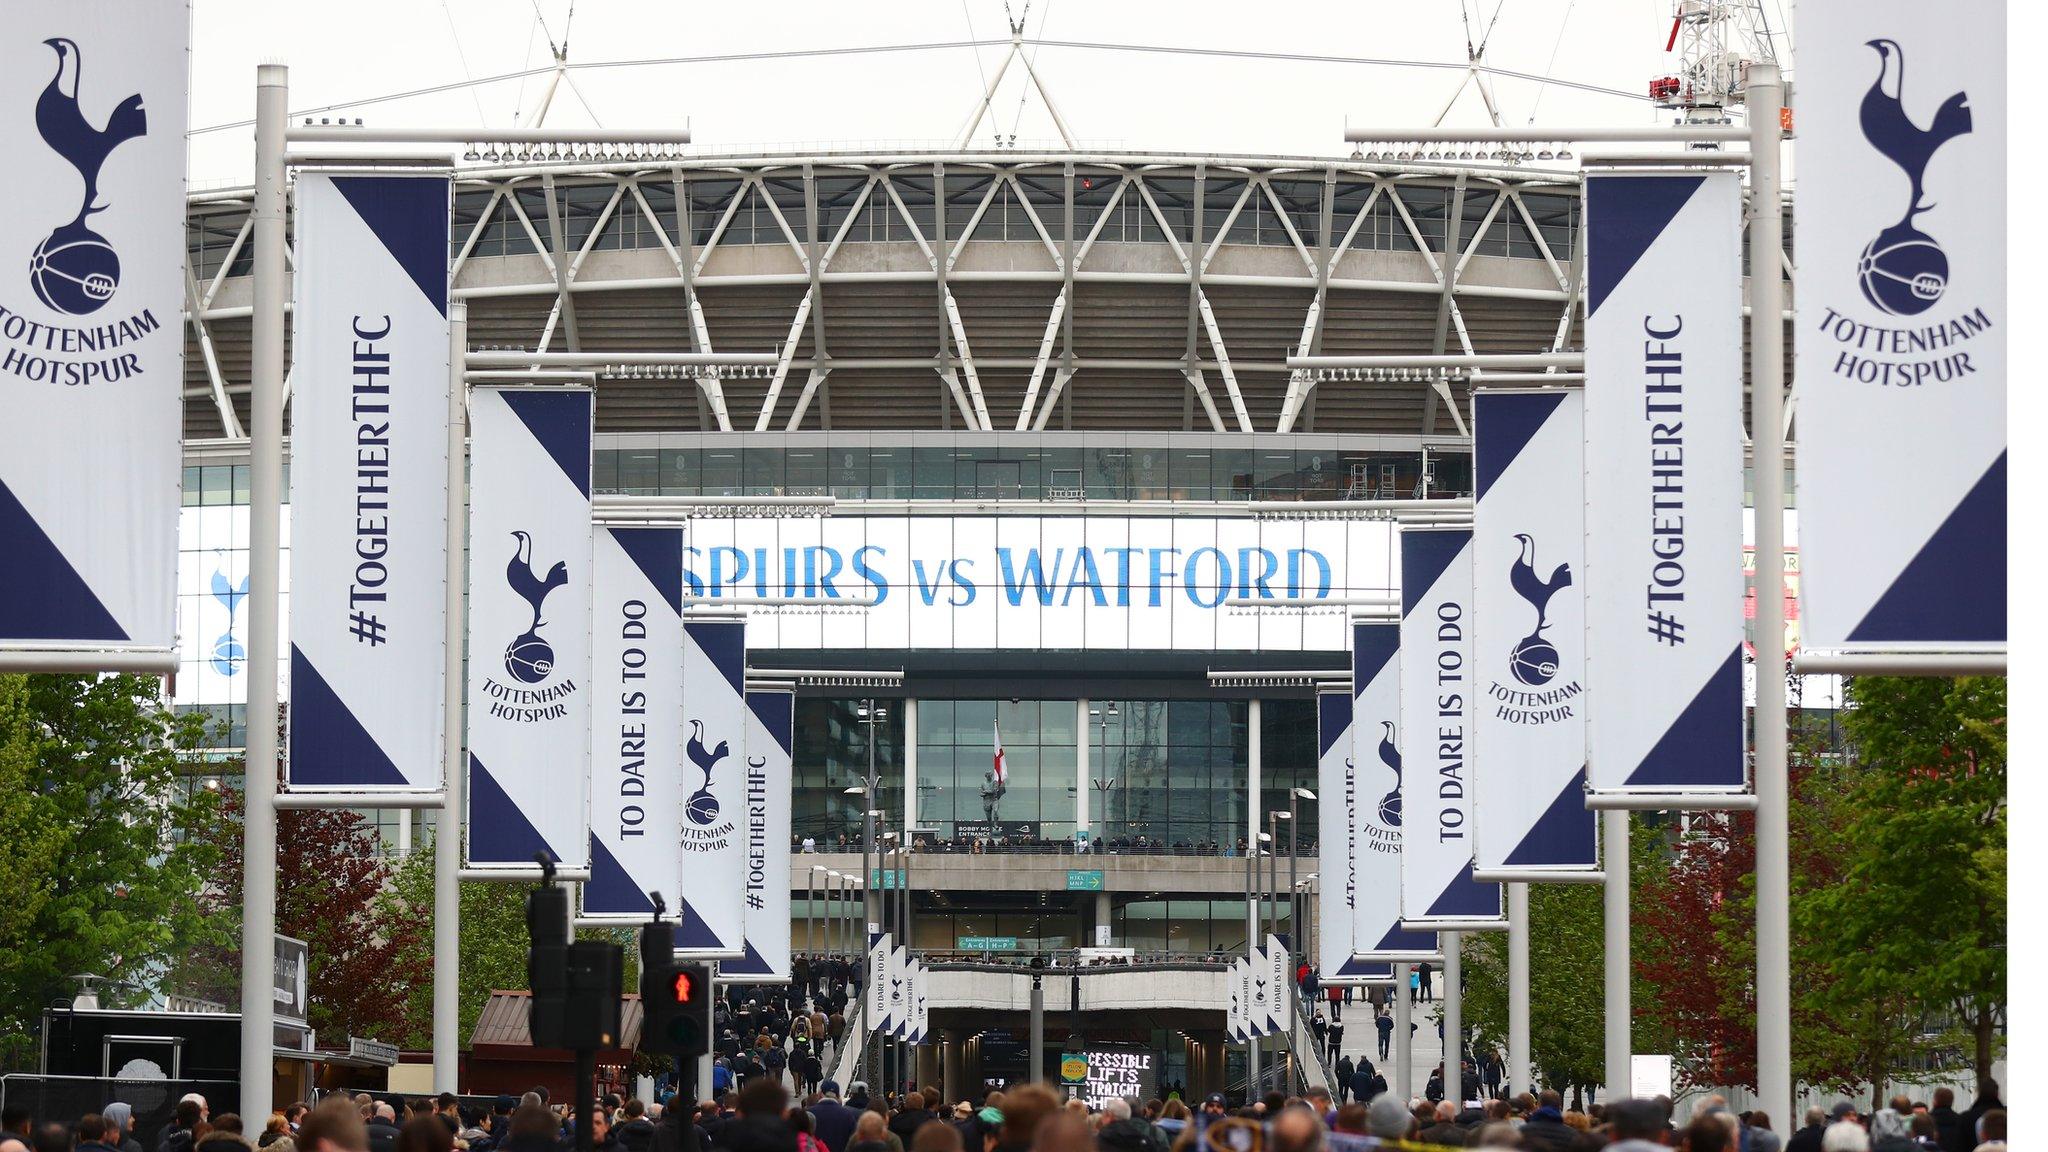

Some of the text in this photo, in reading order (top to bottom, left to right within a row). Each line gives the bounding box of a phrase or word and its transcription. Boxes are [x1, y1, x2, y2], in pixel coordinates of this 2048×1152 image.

[1818, 307, 1992, 354] TOTTENHAM
[2, 348, 144, 386] HOTSPUR
[1833, 351, 1977, 387] HOTSPUR
[349, 314, 391, 647] #TOGETHERTHFC
[1645, 314, 1684, 647] #TOGETHERTHFC
[995, 547, 1332, 608] WATFORD
[482, 677, 576, 705] TOTTENHAM
[1488, 681, 1583, 707] TOTTENHAM
[490, 702, 567, 723] HOTSPUR
[621, 599, 647, 841] TO DARE IS TO DO
[1437, 602, 1464, 843] TO DARE IS TO DO
[1496, 705, 1574, 725] HOTSPUR
[747, 756, 766, 911] #TOGETHERTHFC
[1274, 983, 1282, 1003] DARE
[1083, 1052, 1151, 1069] CESSIBLE
[1087, 1067, 1139, 1083] LIFTS
